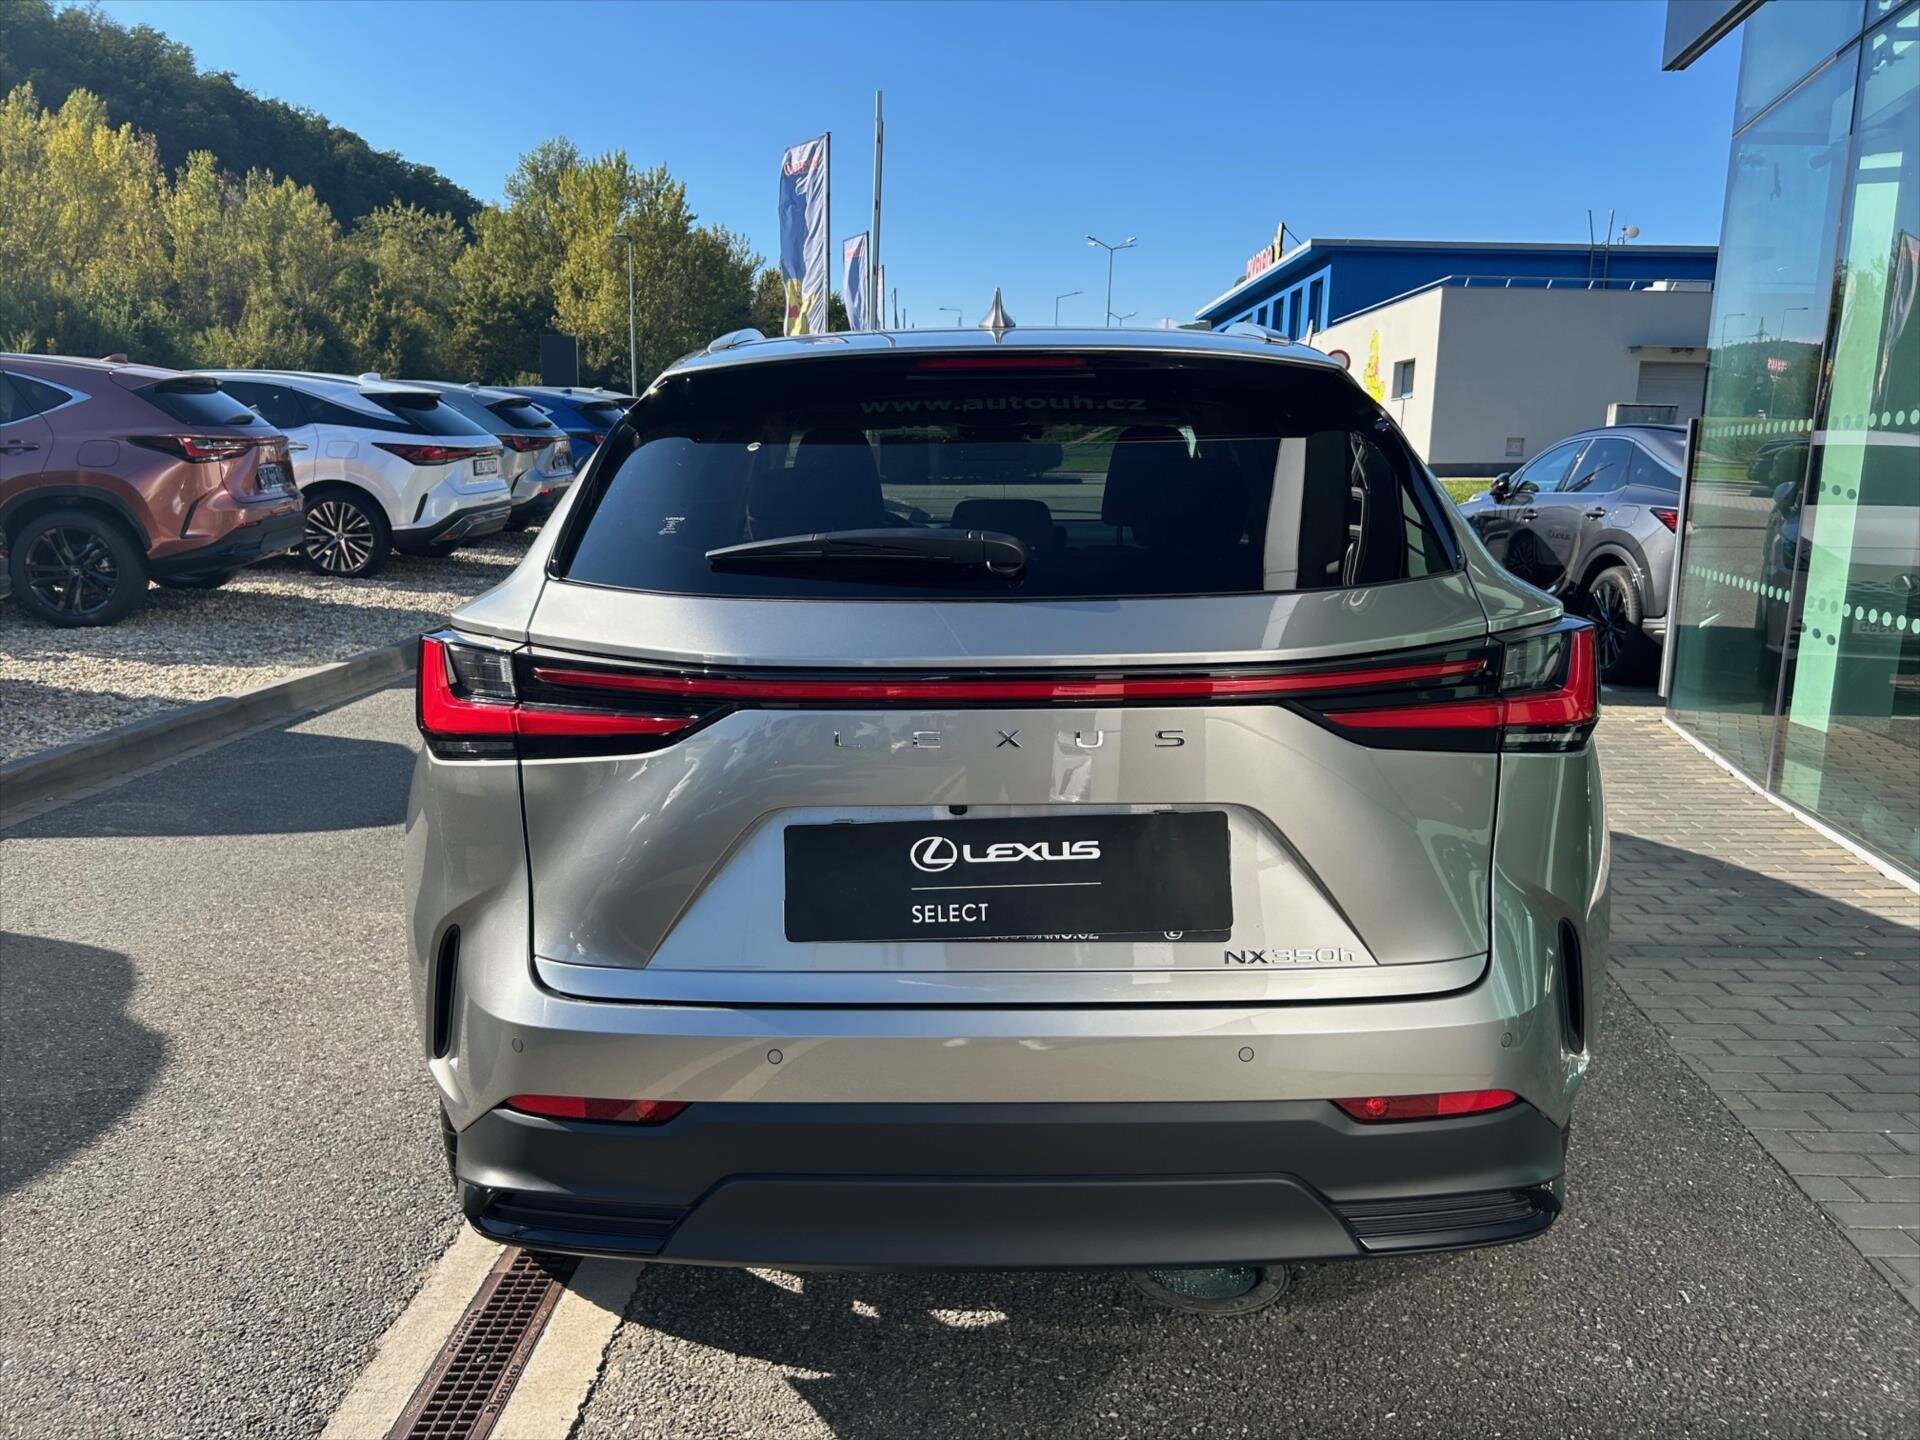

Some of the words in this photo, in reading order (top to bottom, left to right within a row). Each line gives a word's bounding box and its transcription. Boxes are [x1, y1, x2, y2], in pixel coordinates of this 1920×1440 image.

[860, 395, 1148, 414] www.autouh.cz
[833, 729, 1186, 748] LEXUS
[963, 840, 1101, 863] LEXUS
[911, 903, 989, 923] SELECT
